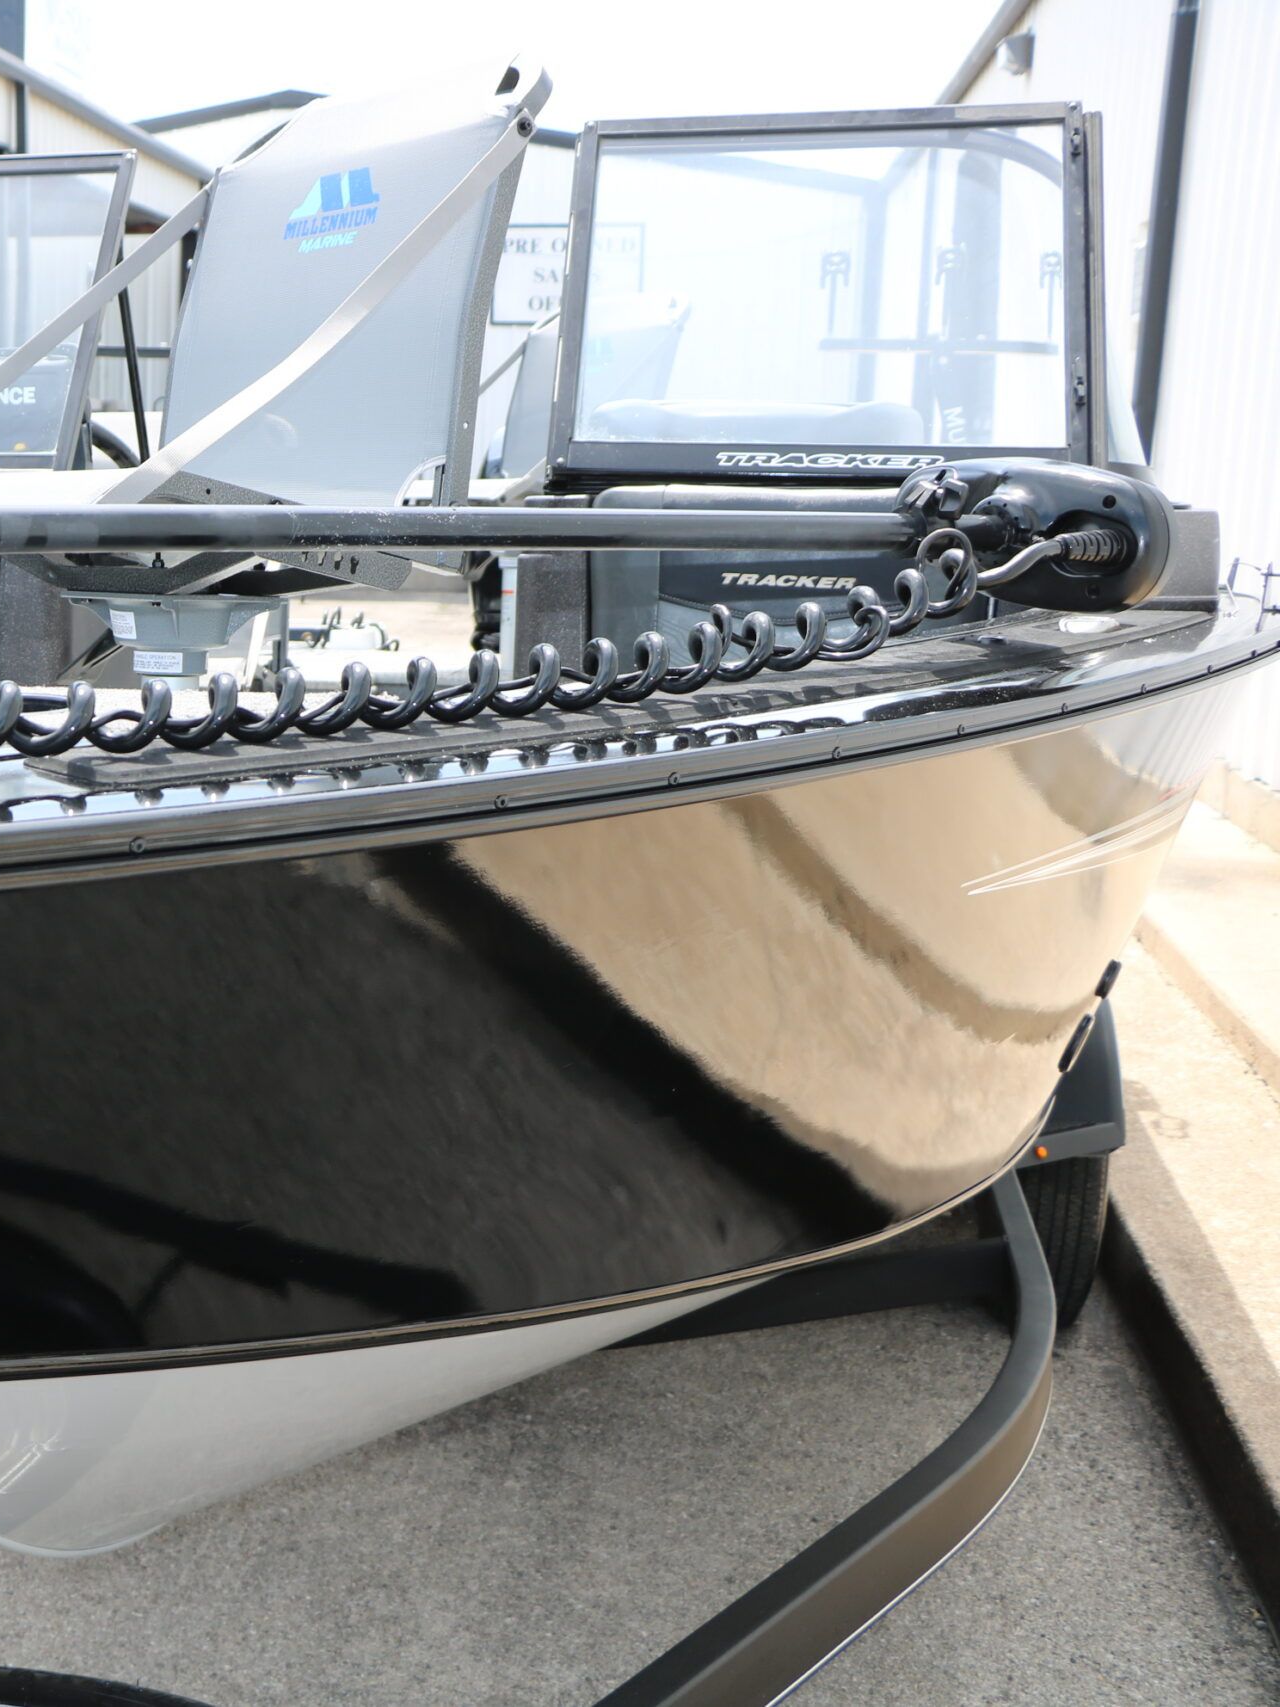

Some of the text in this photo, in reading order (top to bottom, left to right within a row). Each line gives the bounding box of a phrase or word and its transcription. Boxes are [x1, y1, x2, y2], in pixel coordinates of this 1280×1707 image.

[284, 206, 379, 241] MILLENNIUM
[297, 231, 359, 254] MARINE
[503, 237, 542, 254] PRE
[716, 452, 945, 469] TRACKER
[721, 572, 857, 590] TRACKER
